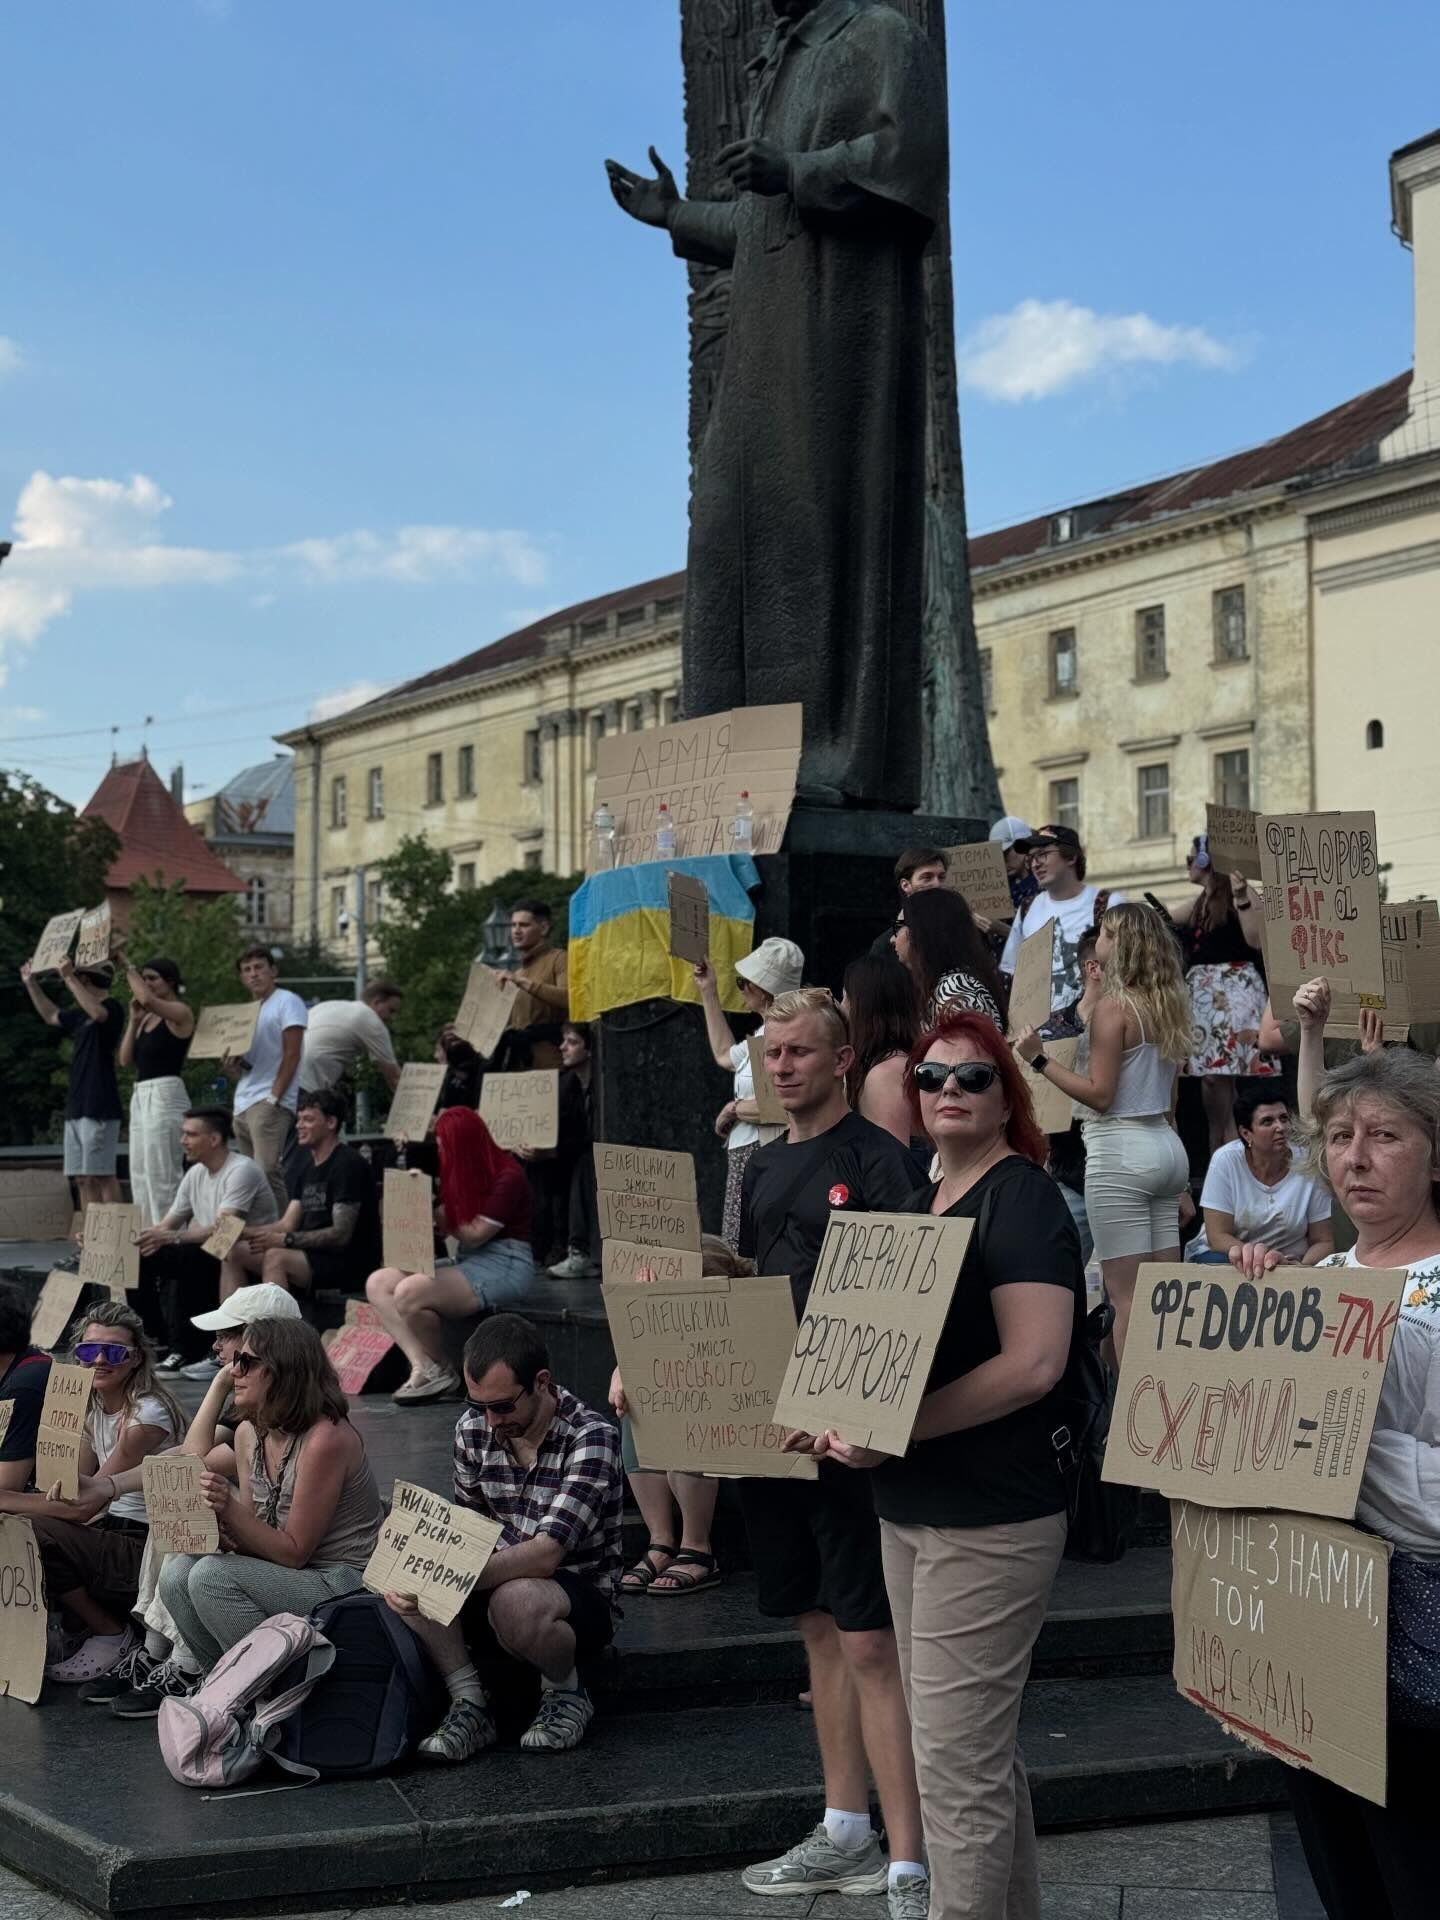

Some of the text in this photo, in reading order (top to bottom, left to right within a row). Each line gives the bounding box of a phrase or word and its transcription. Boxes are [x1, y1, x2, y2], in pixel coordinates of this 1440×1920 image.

[626, 723, 731, 792] АРМІЯ
[1265, 822, 1377, 885] ФЕДОРОВ
[484, 1072, 554, 1104] ФЕДОРОВ
[615, 1209, 685, 1235] ФЕДОРОВ
[624, 1296, 731, 1341] БІЛЕЦЬКИЙ
[653, 1358, 757, 1389] СИРСЬКОГО
[791, 1314, 922, 1411] ФЕДОРОВА
[51, 1375, 84, 1397] ВЛАДА
[50, 1409, 79, 1430] ПРОТИ
[37, 1441, 76, 1460] ПЕРЕМОГИ
[390, 1532, 410, 1552] НЕ
[1230, 1510, 1259, 1574] НЕ
[402, 1553, 477, 1596] РЕФОРМИ
[1210, 1577, 1265, 1635] ТОЙ
[1192, 1625, 1314, 1745] МОСКАЛЬ
